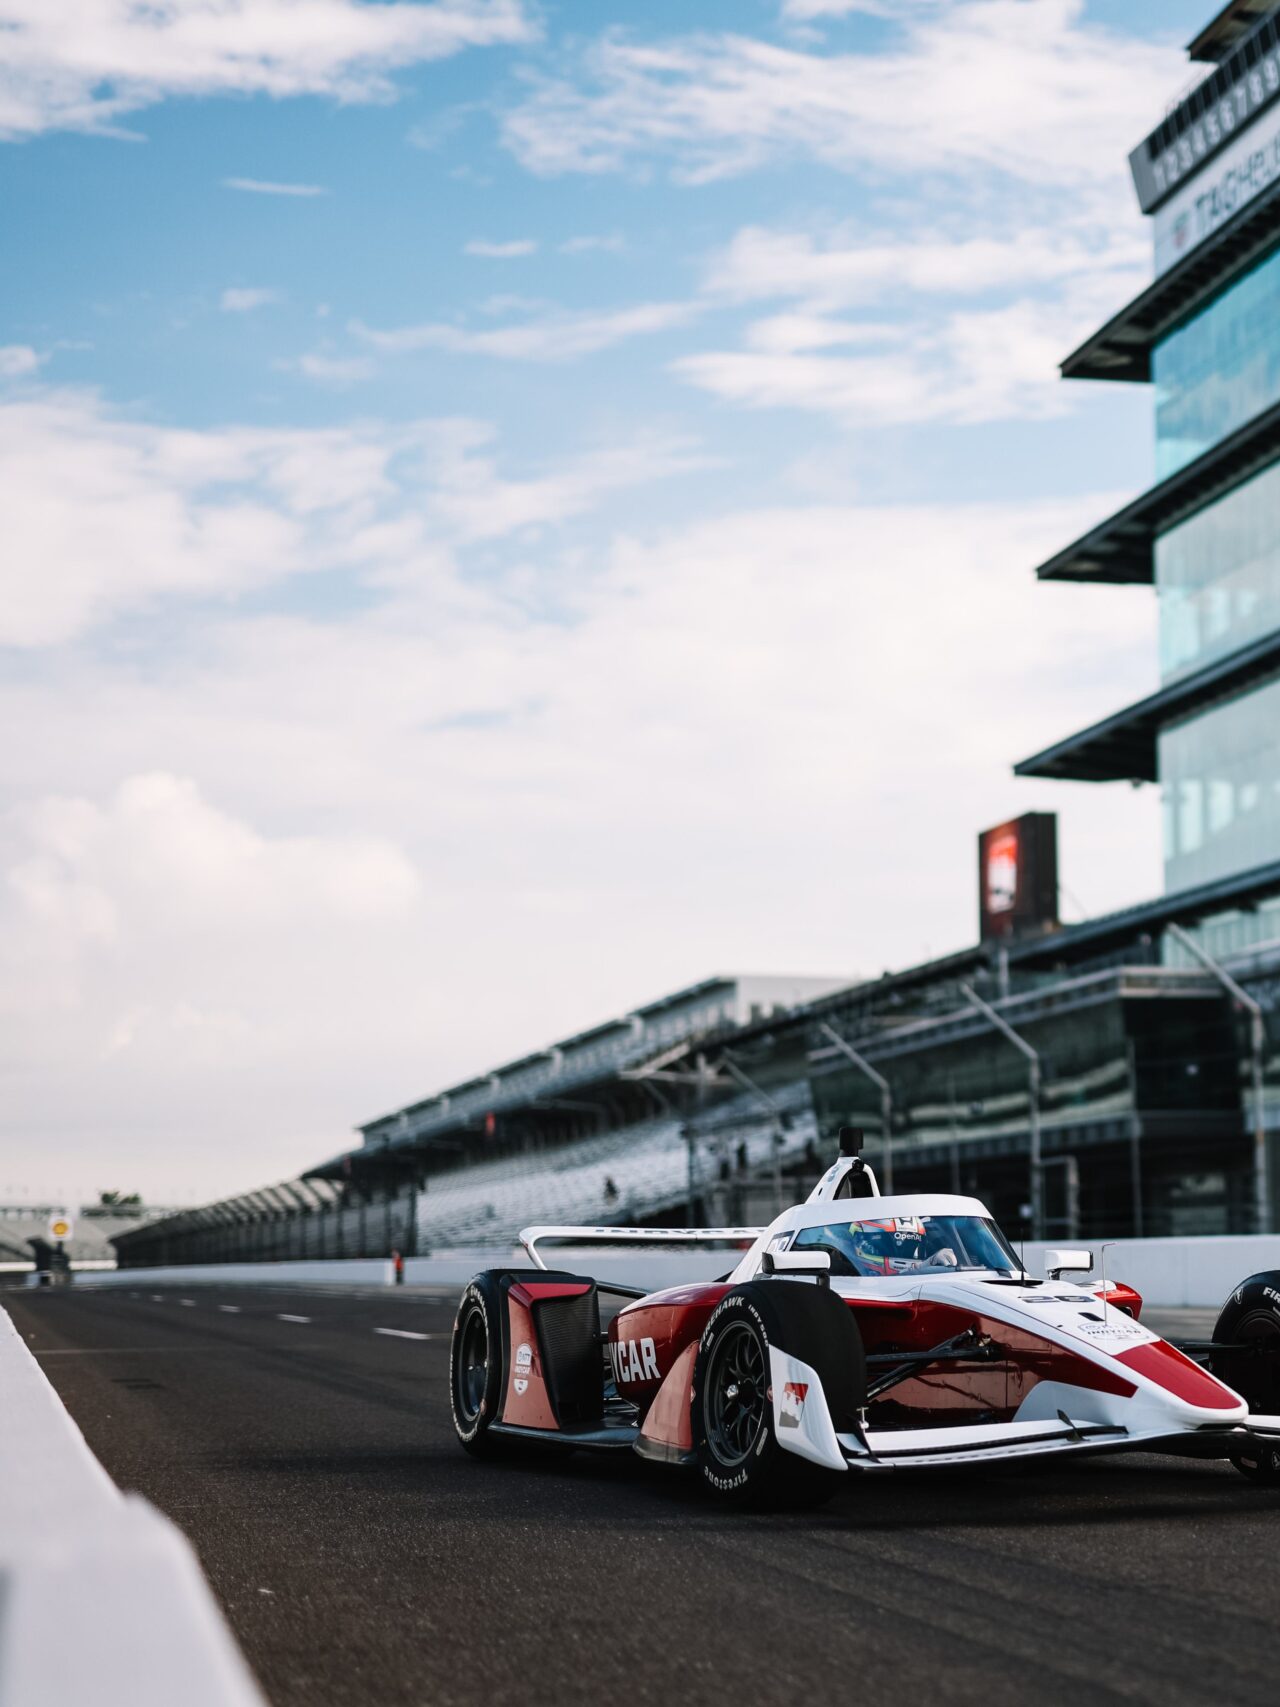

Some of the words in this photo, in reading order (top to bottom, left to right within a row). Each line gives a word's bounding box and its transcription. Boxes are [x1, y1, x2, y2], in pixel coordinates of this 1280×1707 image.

[894, 1232, 922, 1241] OpenAI
[608, 1337, 662, 1383] YCAR
[704, 1466, 748, 1490] Firestone
